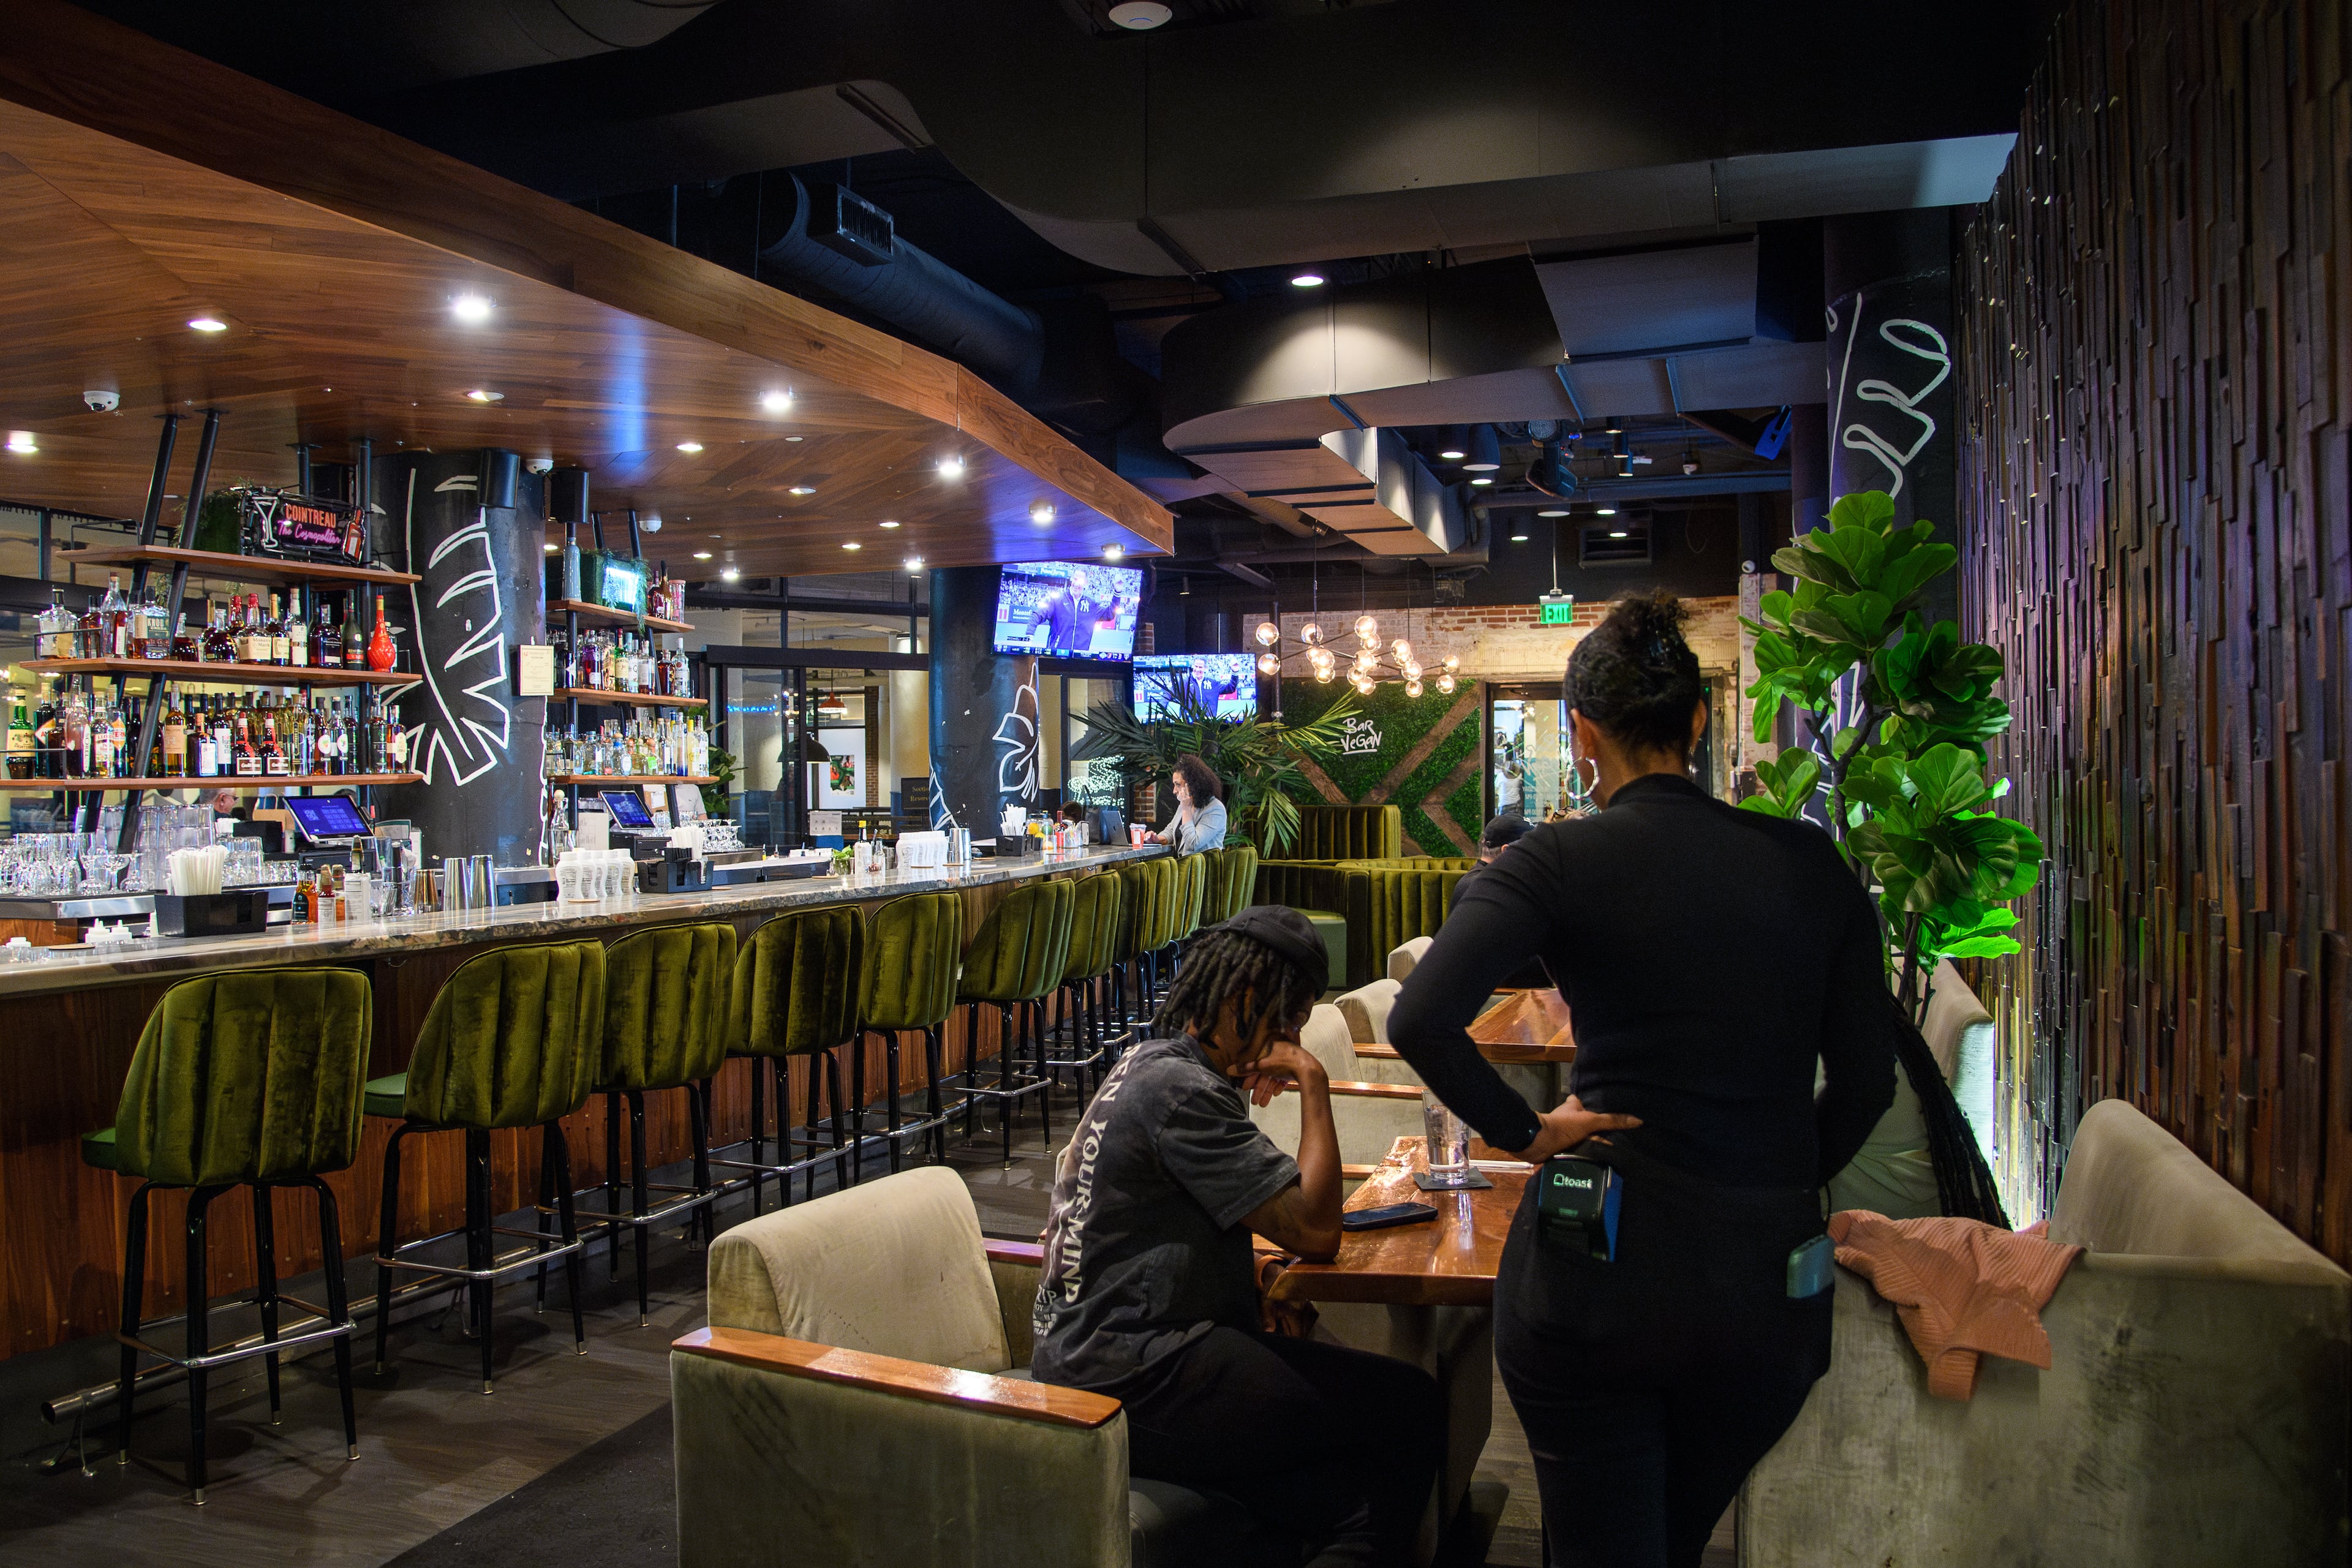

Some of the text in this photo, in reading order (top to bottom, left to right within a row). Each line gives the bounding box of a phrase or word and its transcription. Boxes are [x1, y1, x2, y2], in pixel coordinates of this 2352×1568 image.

[285, 504, 336, 528] COINTREAU
[277, 520, 292, 536] The
[1545, 605, 1569, 622] EXIT
[147, 618, 164, 627] KNOB
[1076, 1118, 1107, 1213] YOUR
[1564, 1176, 1593, 1189] toast
[1061, 1216, 1085, 1303] MIND
